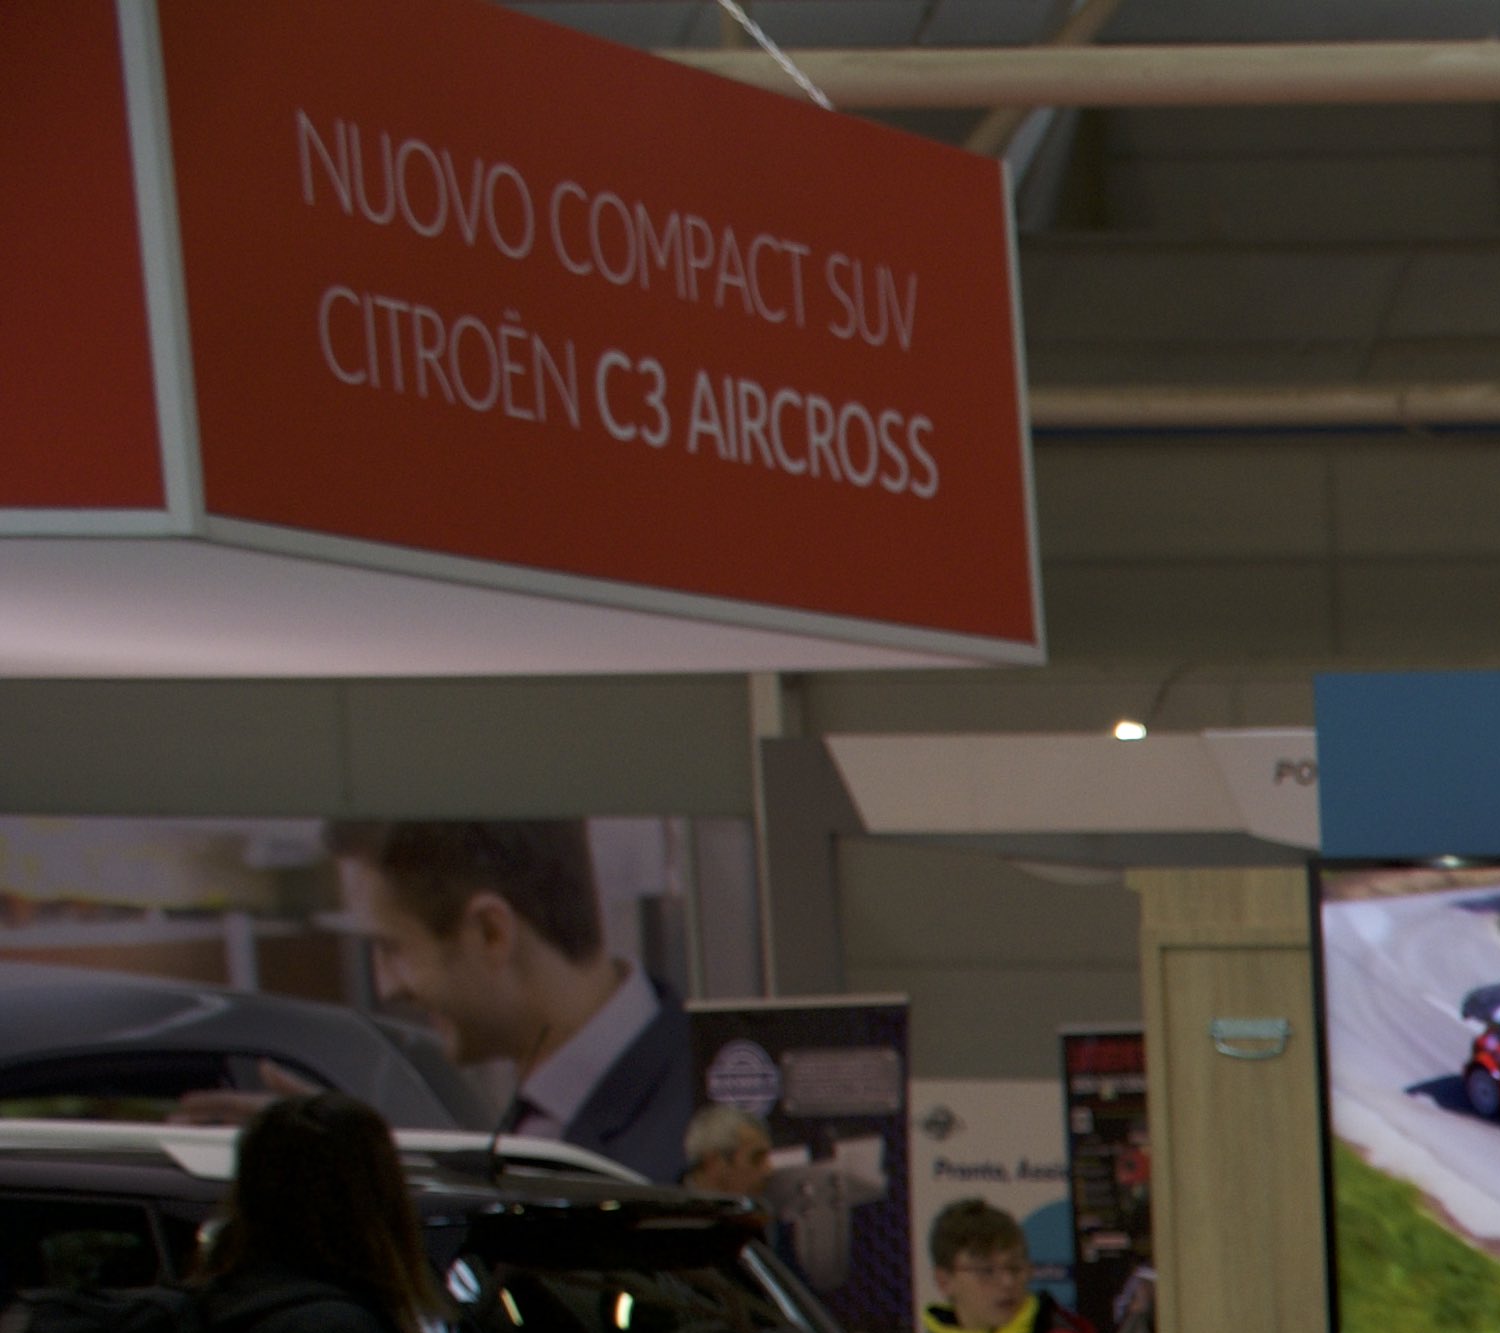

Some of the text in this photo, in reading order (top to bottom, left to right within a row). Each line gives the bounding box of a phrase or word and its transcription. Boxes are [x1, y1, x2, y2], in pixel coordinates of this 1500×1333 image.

[296, 111, 917, 352] NUOVO COMPACT SUV
[319, 286, 939, 497] CITROËN C3 AIRCROSS
